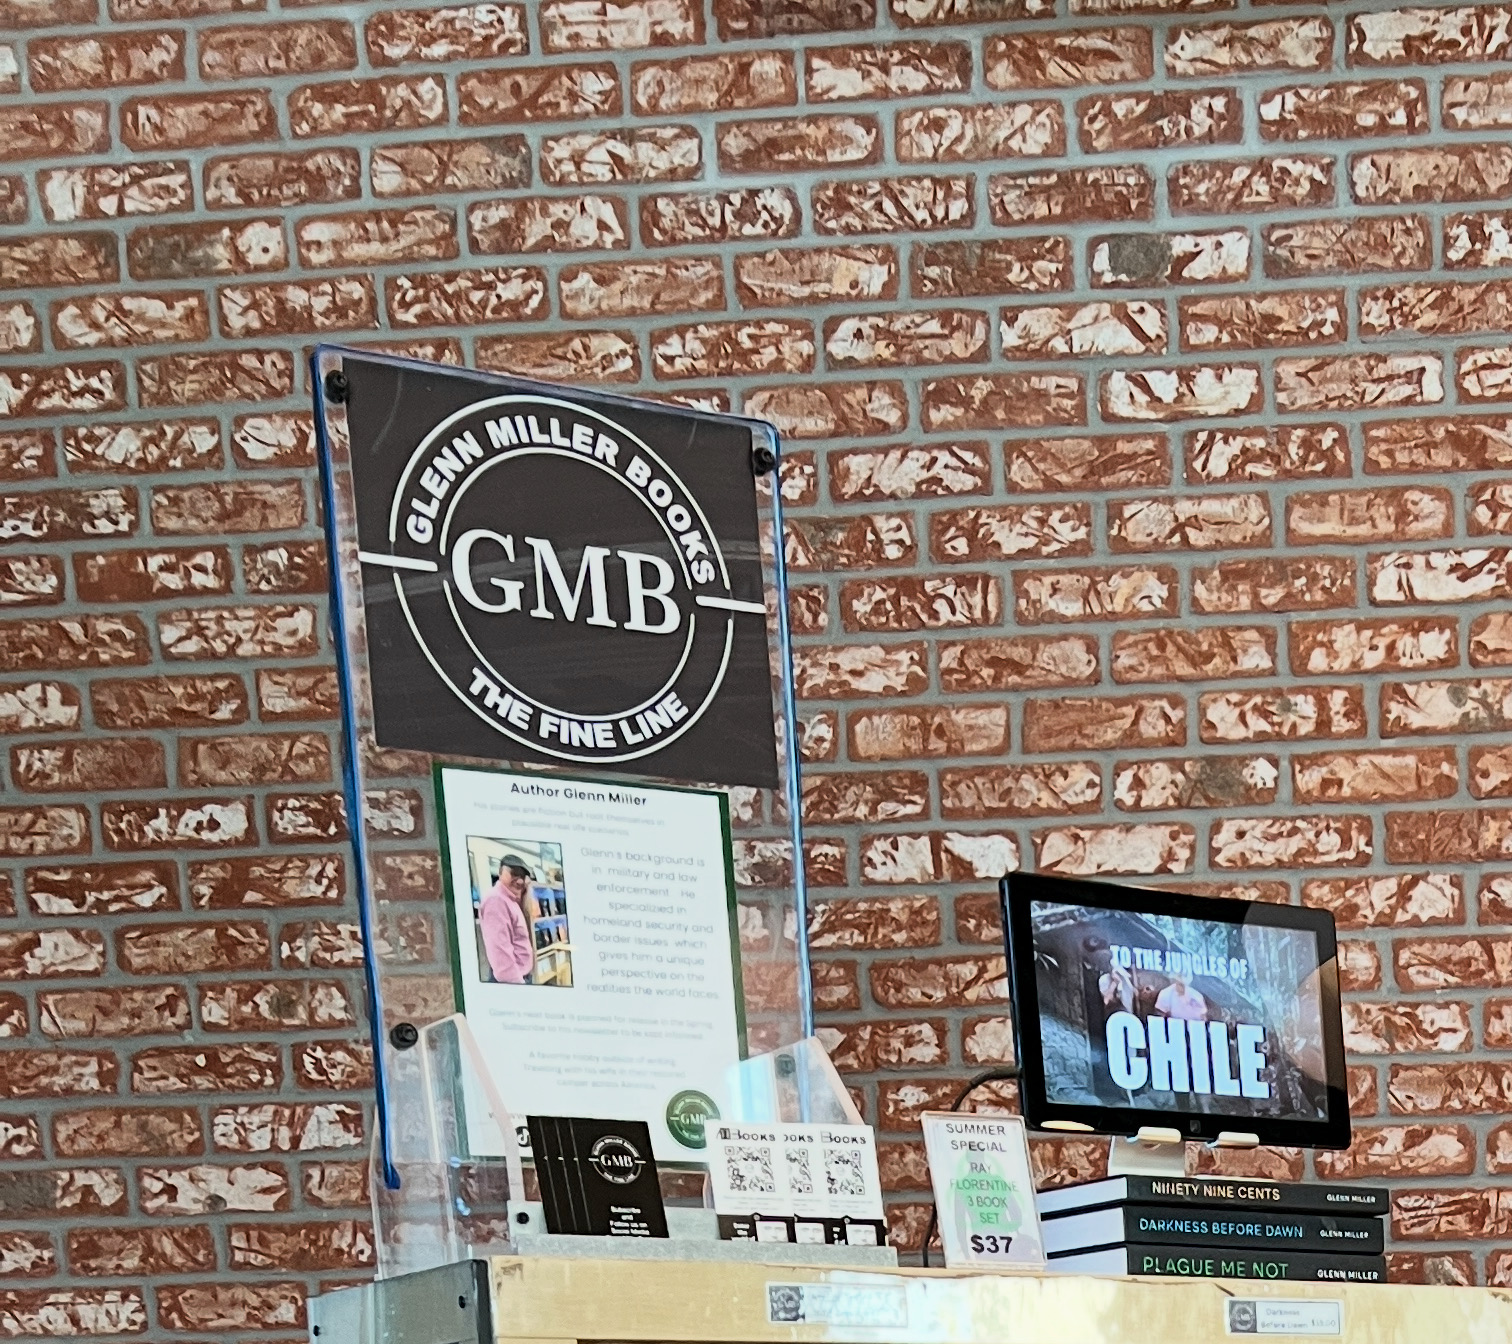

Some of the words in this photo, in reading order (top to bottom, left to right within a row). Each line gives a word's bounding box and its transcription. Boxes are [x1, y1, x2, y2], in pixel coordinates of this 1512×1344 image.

[406, 430, 486, 544] GLENN
[486, 415, 619, 466] MILLER
[625, 457, 716, 585] BOOKS
[451, 528, 682, 635] GMB
[467, 667, 532, 731] THE
[539, 716, 617, 749] FINE
[619, 692, 689, 746] LINE
[511, 783, 559, 798] Author
[564, 788, 605, 802] Glenn
[609, 791, 646, 806] Miller
[625, 850, 693, 868] background
[608, 866, 649, 880] military
[653, 868, 675, 881] and
[678, 871, 697, 882] law
[677, 905, 687, 914] in
[583, 915, 642, 929] homeland
[646, 919, 688, 933] security
[692, 922, 713, 934] and
[593, 933, 632, 945] border
[675, 938, 707, 949] which
[598, 950, 628, 962] gives
[632, 952, 649, 962] him
[666, 956, 704, 968] unique
[1110, 945, 1131, 969] TO
[1132, 947, 1163, 971] THE
[1165, 950, 1226, 977] JUNGLES
[1229, 957, 1248, 979] OF
[601, 967, 666, 982] perspective
[670, 972, 684, 981] on
[687, 972, 704, 982] the
[586, 982, 631, 995] realities
[634, 985, 652, 996] the
[655, 986, 685, 997] world
[1105, 1011, 1272, 1099] CHILE
[946, 1123, 1006, 1135] SUMMER
[951, 1140, 1007, 1152] SPECIAL
[600, 1154, 633, 1167] GMB
[970, 1162, 992, 1173] RAY
[950, 1179, 1018, 1192] FLORENTINE
[1152, 1180, 1199, 1197] NINETY
[1203, 1184, 1235, 1198] NINE
[1237, 1186, 1281, 1201] CENTS
[1326, 1193, 1350, 1202] GLENN
[1351, 1194, 1376, 1204] MILLER
[967, 1197, 974, 1206] 3
[977, 1197, 1007, 1208] BOOK
[980, 1213, 1000, 1224] SET
[1139, 1218, 1208, 1234] DARKNESS
[1211, 1221, 1262, 1236] BEFORE
[1265, 1224, 1303, 1238] DAWN
[1319, 1229, 1342, 1237] GLENN
[1344, 1230, 1369, 1239] MILLER
[970, 1234, 1013, 1254] $37
[1143, 1256, 1217, 1276] PLAGUE
[1220, 1260, 1248, 1276] ME
[1252, 1262, 1288, 1278] NOT
[1317, 1268, 1346, 1279] GLENN
[1348, 1270, 1378, 1281] MILLER
